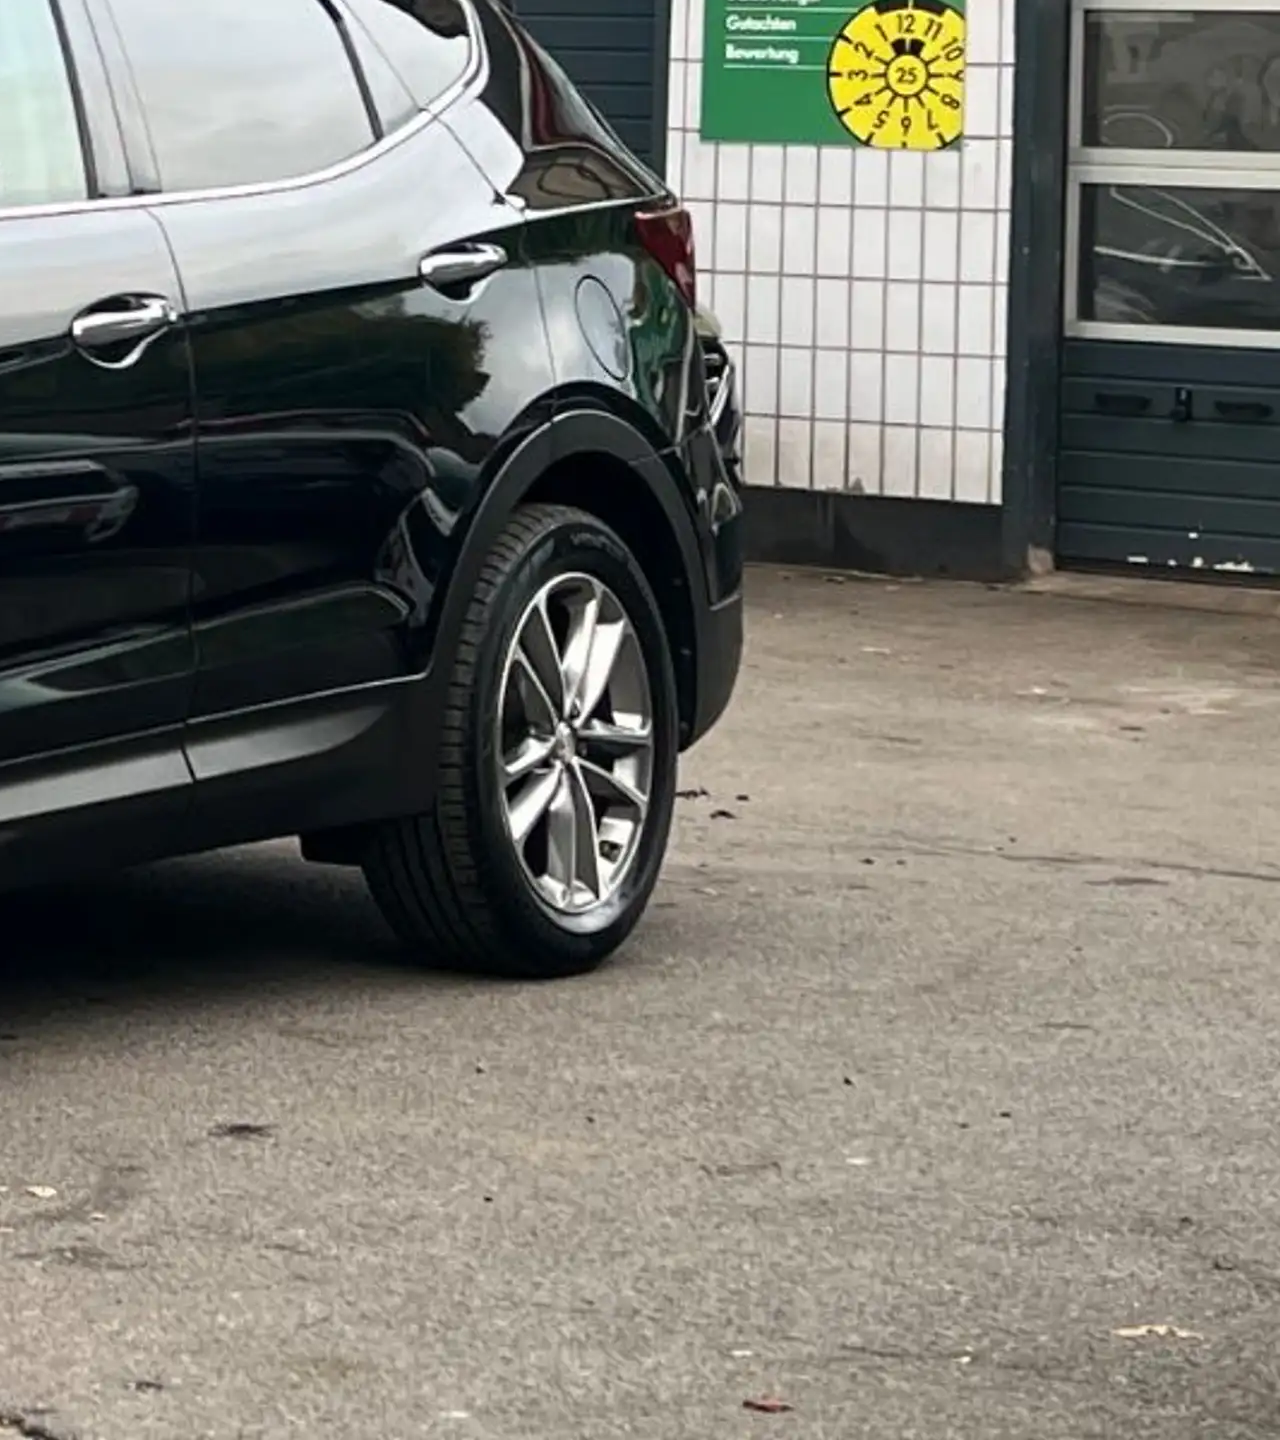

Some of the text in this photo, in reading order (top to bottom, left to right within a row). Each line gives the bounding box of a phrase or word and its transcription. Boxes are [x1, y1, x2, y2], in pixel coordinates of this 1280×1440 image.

[726, 14, 797, 32] Gutachten
[895, 13, 915, 35] 12
[924, 17, 944, 42] 11
[725, 43, 800, 65] Bewertung
[853, 41, 874, 60] 2
[941, 36, 965, 62] 10
[847, 69, 869, 82] 3
[895, 67, 917, 85] 25
